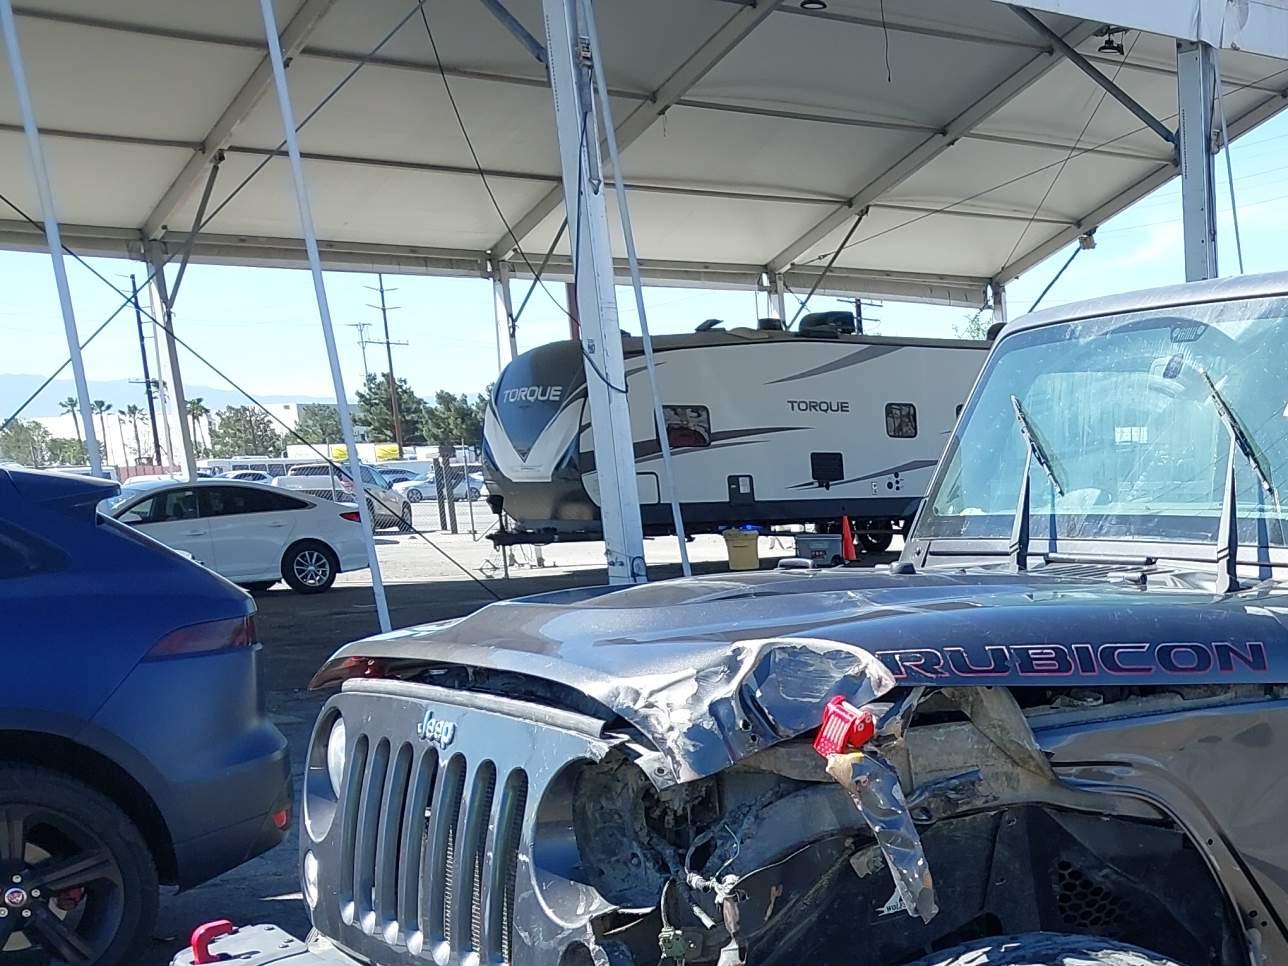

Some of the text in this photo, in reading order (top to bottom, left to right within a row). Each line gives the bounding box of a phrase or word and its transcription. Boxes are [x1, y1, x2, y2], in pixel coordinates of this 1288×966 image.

[503, 385, 563, 403] TORQUE
[786, 400, 850, 414] TORQUE
[874, 642, 1269, 678] RUBICON
[417, 710, 456, 750] Jeep
